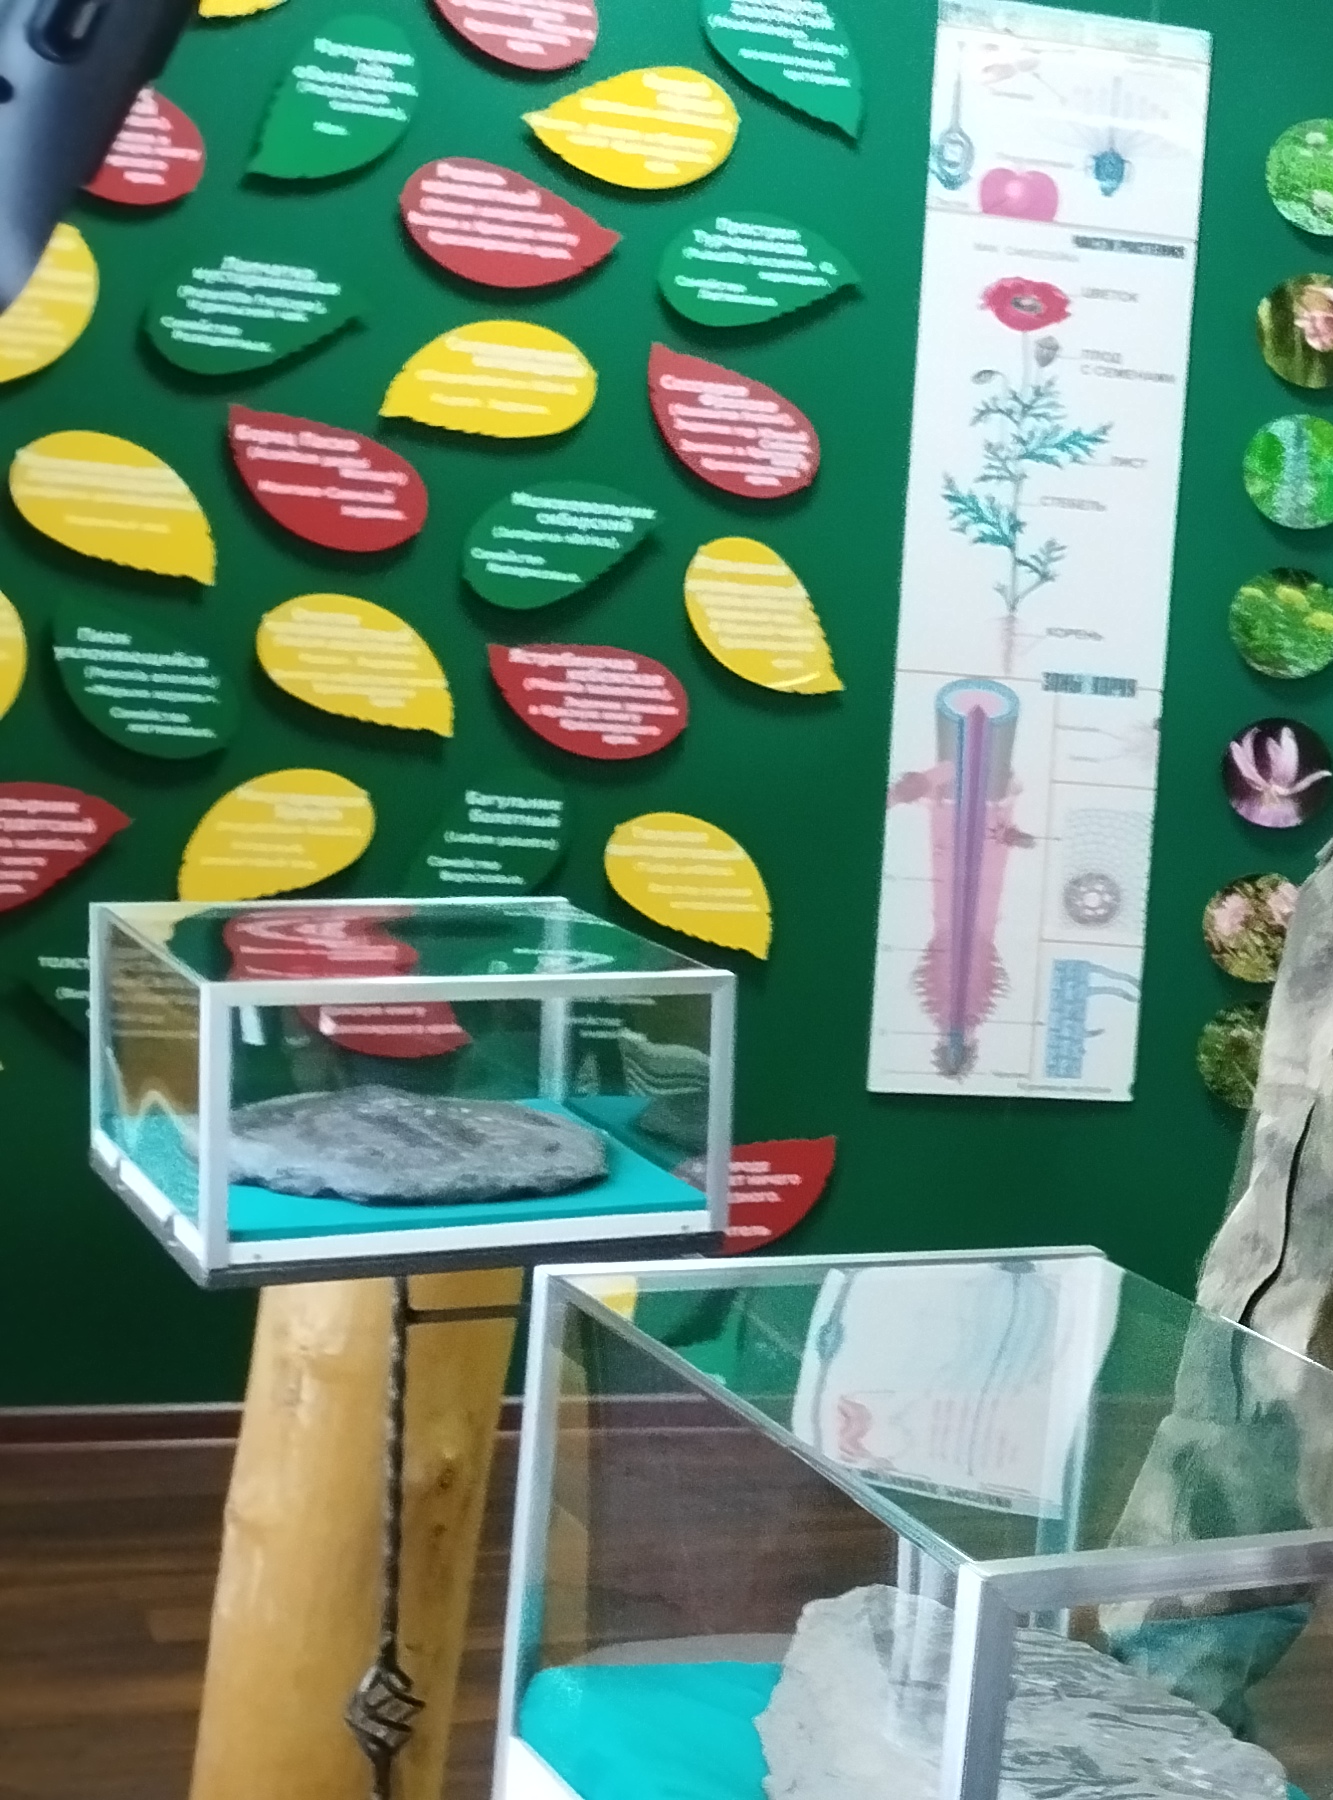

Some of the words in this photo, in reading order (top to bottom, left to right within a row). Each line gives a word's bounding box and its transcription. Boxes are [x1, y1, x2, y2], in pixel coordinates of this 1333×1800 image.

[1081, 287, 1139, 303] ЦВЕТОК
[1110, 456, 1148, 468] ЛИСТ
[536, 511, 634, 532] сибирский
[1046, 628, 1104, 641] КОРЕНЬ
[465, 790, 563, 811] Багульник
[468, 808, 561, 828] болотный
